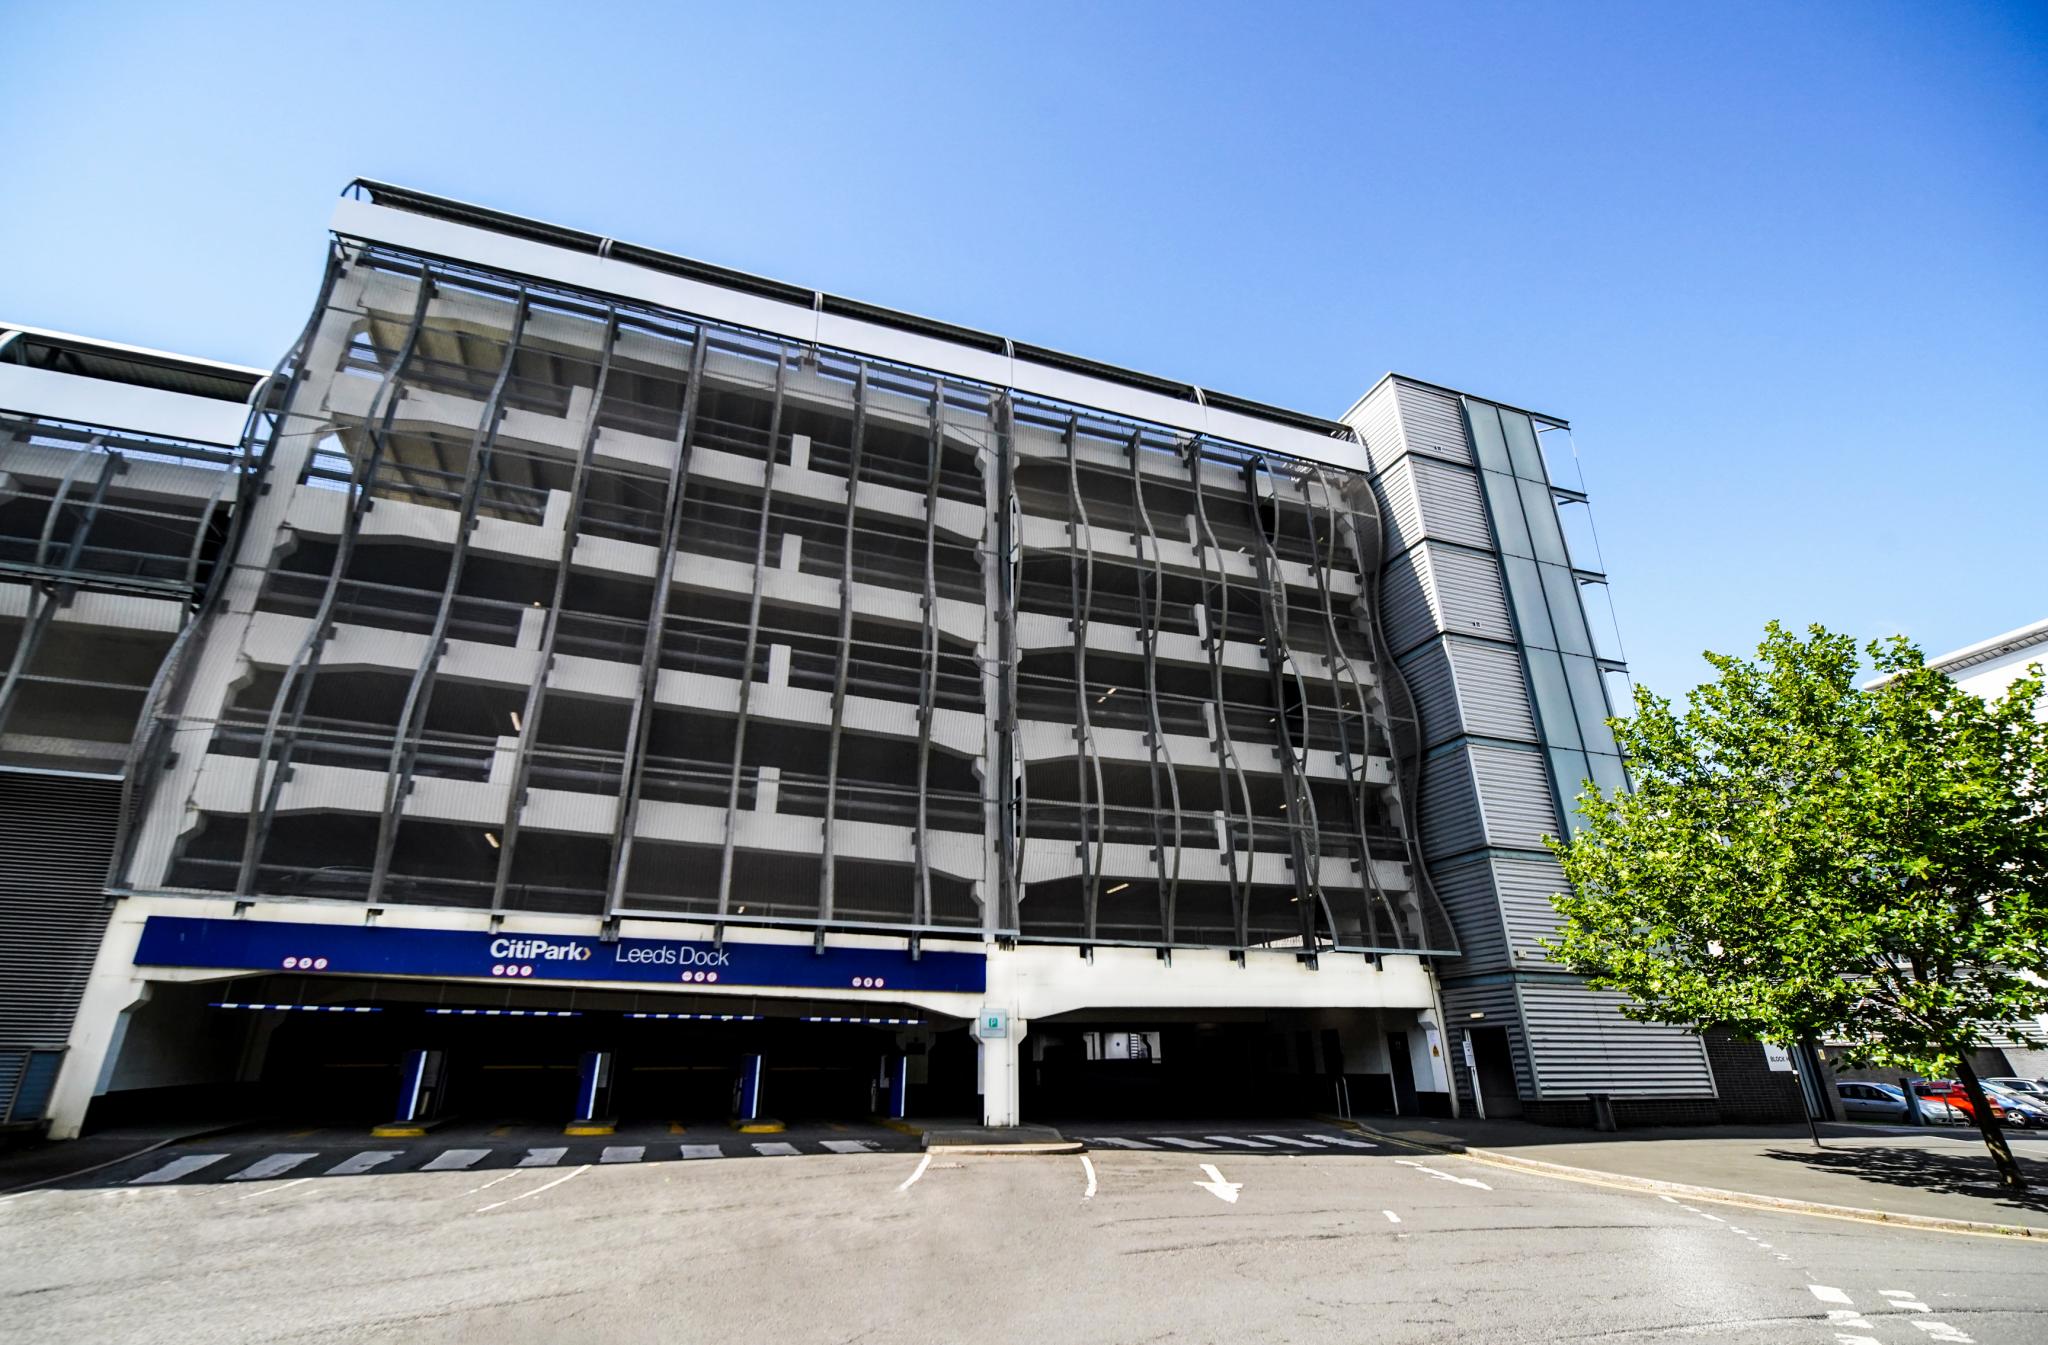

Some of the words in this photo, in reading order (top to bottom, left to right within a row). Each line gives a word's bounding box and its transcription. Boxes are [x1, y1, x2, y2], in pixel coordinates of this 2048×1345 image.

[490, 938, 584, 961] CitiPark
[615, 943, 676, 965] Leeds
[679, 946, 730, 967] Dock
